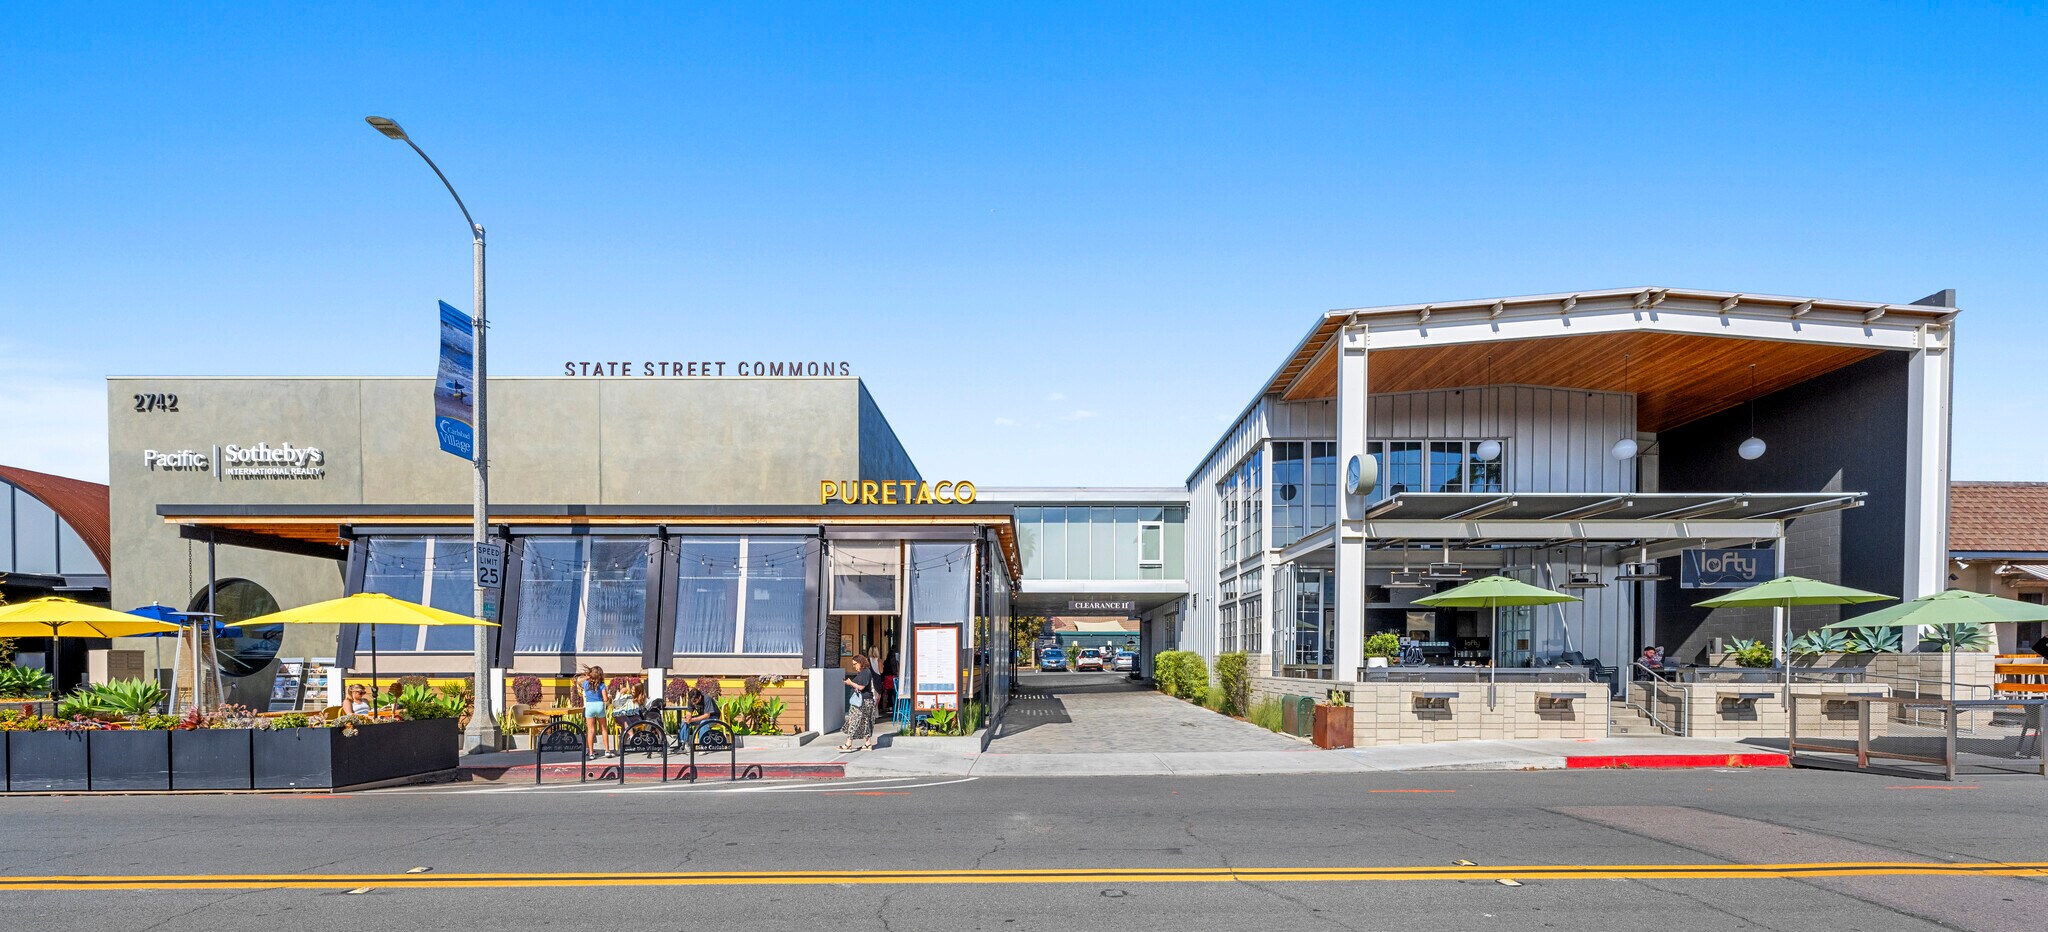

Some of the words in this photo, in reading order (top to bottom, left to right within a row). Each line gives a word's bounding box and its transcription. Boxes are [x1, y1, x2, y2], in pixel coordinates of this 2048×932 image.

[565, 361, 632, 376] STATE
[644, 361, 726, 376] STREET
[738, 361, 850, 376] COMMONS
[134, 393, 178, 411] 2742
[440, 432, 470, 453] Village
[144, 449, 204, 467] Pacific
[225, 442, 321, 466] Sotheby's
[820, 480, 977, 505] PURETACO
[478, 547, 500, 557] SPEED
[480, 557, 497, 566] LIMIT
[1701, 552, 1756, 579] lofty
[480, 567, 498, 584] 25
